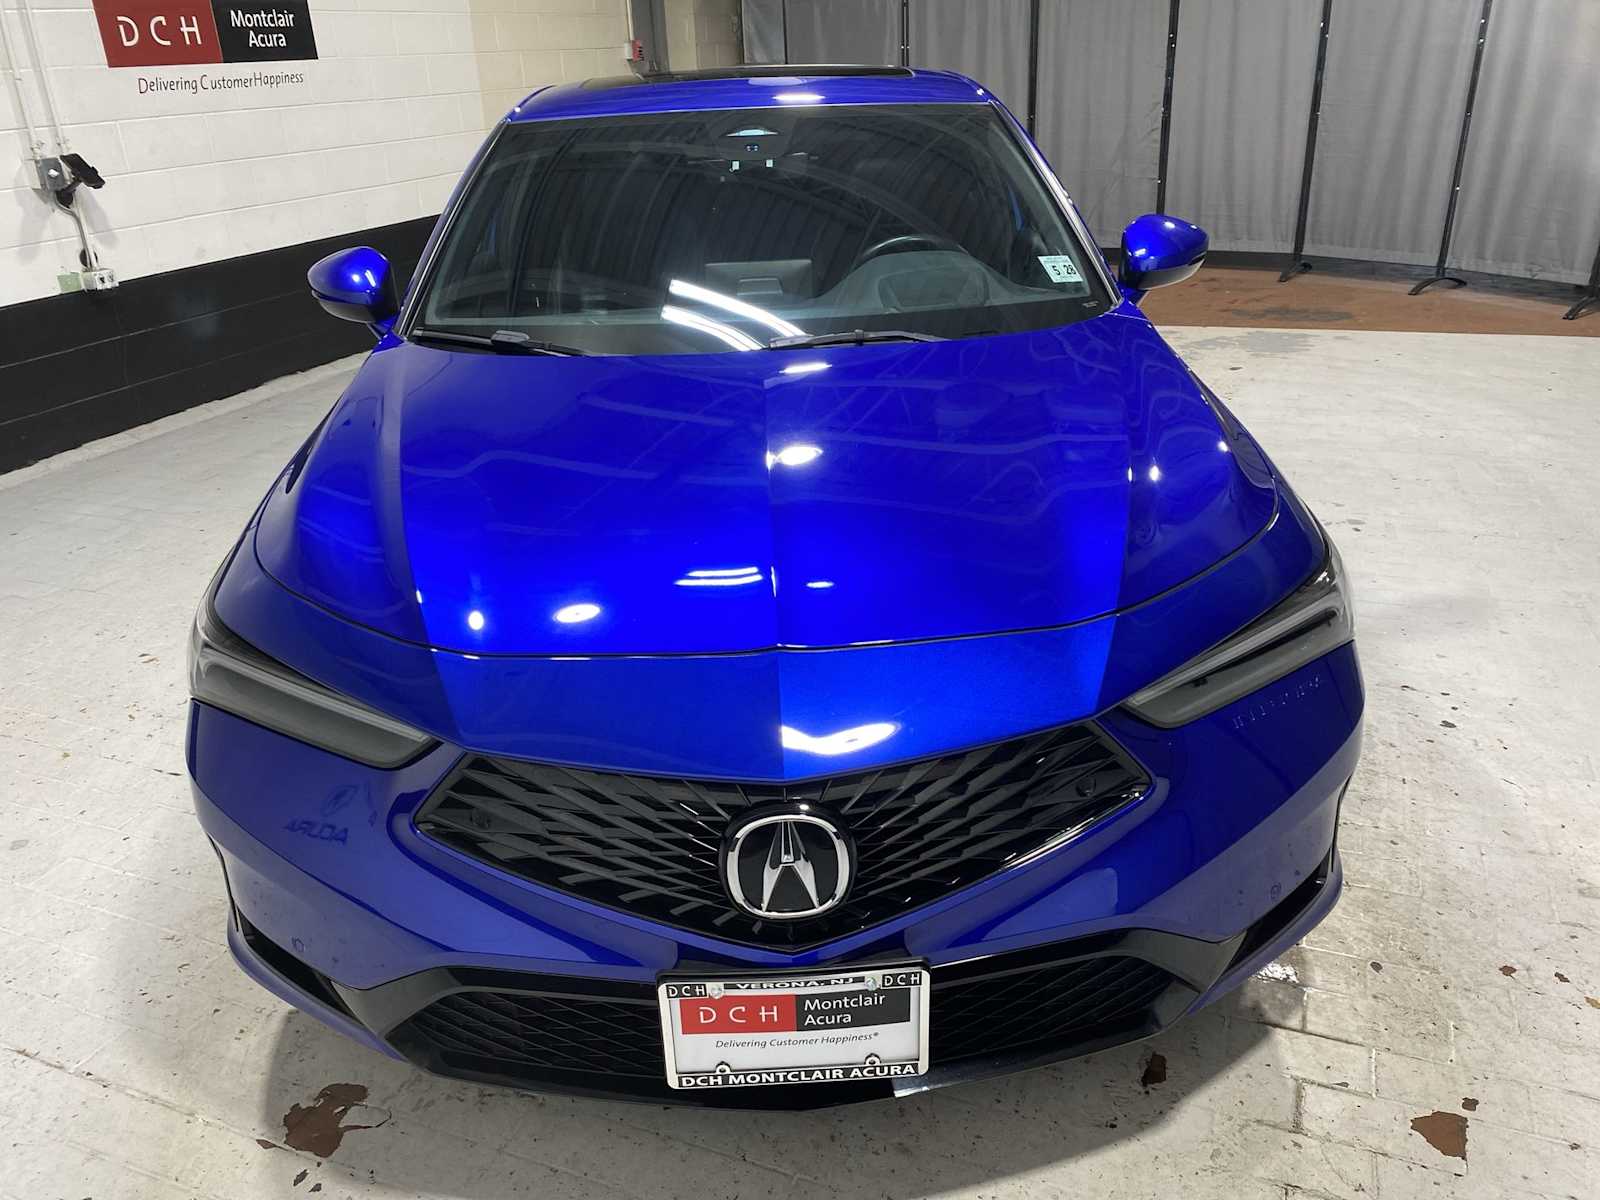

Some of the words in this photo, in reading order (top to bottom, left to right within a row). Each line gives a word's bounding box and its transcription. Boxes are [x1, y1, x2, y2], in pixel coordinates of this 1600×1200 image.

[230, 9, 295, 28] Montclair
[116, 15, 202, 47] DCH
[249, 30, 287, 48] Acura
[138, 77, 198, 94] Delivering
[200, 74, 253, 91] Customer
[253, 71, 304, 88] Happiness
[1052, 265, 1060, 276] 5
[883, 972, 921, 987] DCH
[667, 984, 706, 998] DCH
[804, 993, 885, 1011] Montclair
[700, 1006, 778, 1024] DCH
[804, 1013, 852, 1026] Acura
[715, 1038, 767, 1049] Delivering
[769, 1036, 819, 1048] Customer
[681, 1075, 725, 1088] DCH
[728, 1069, 844, 1085] MONTCLAIR
[850, 1064, 916, 1078] ACURA
